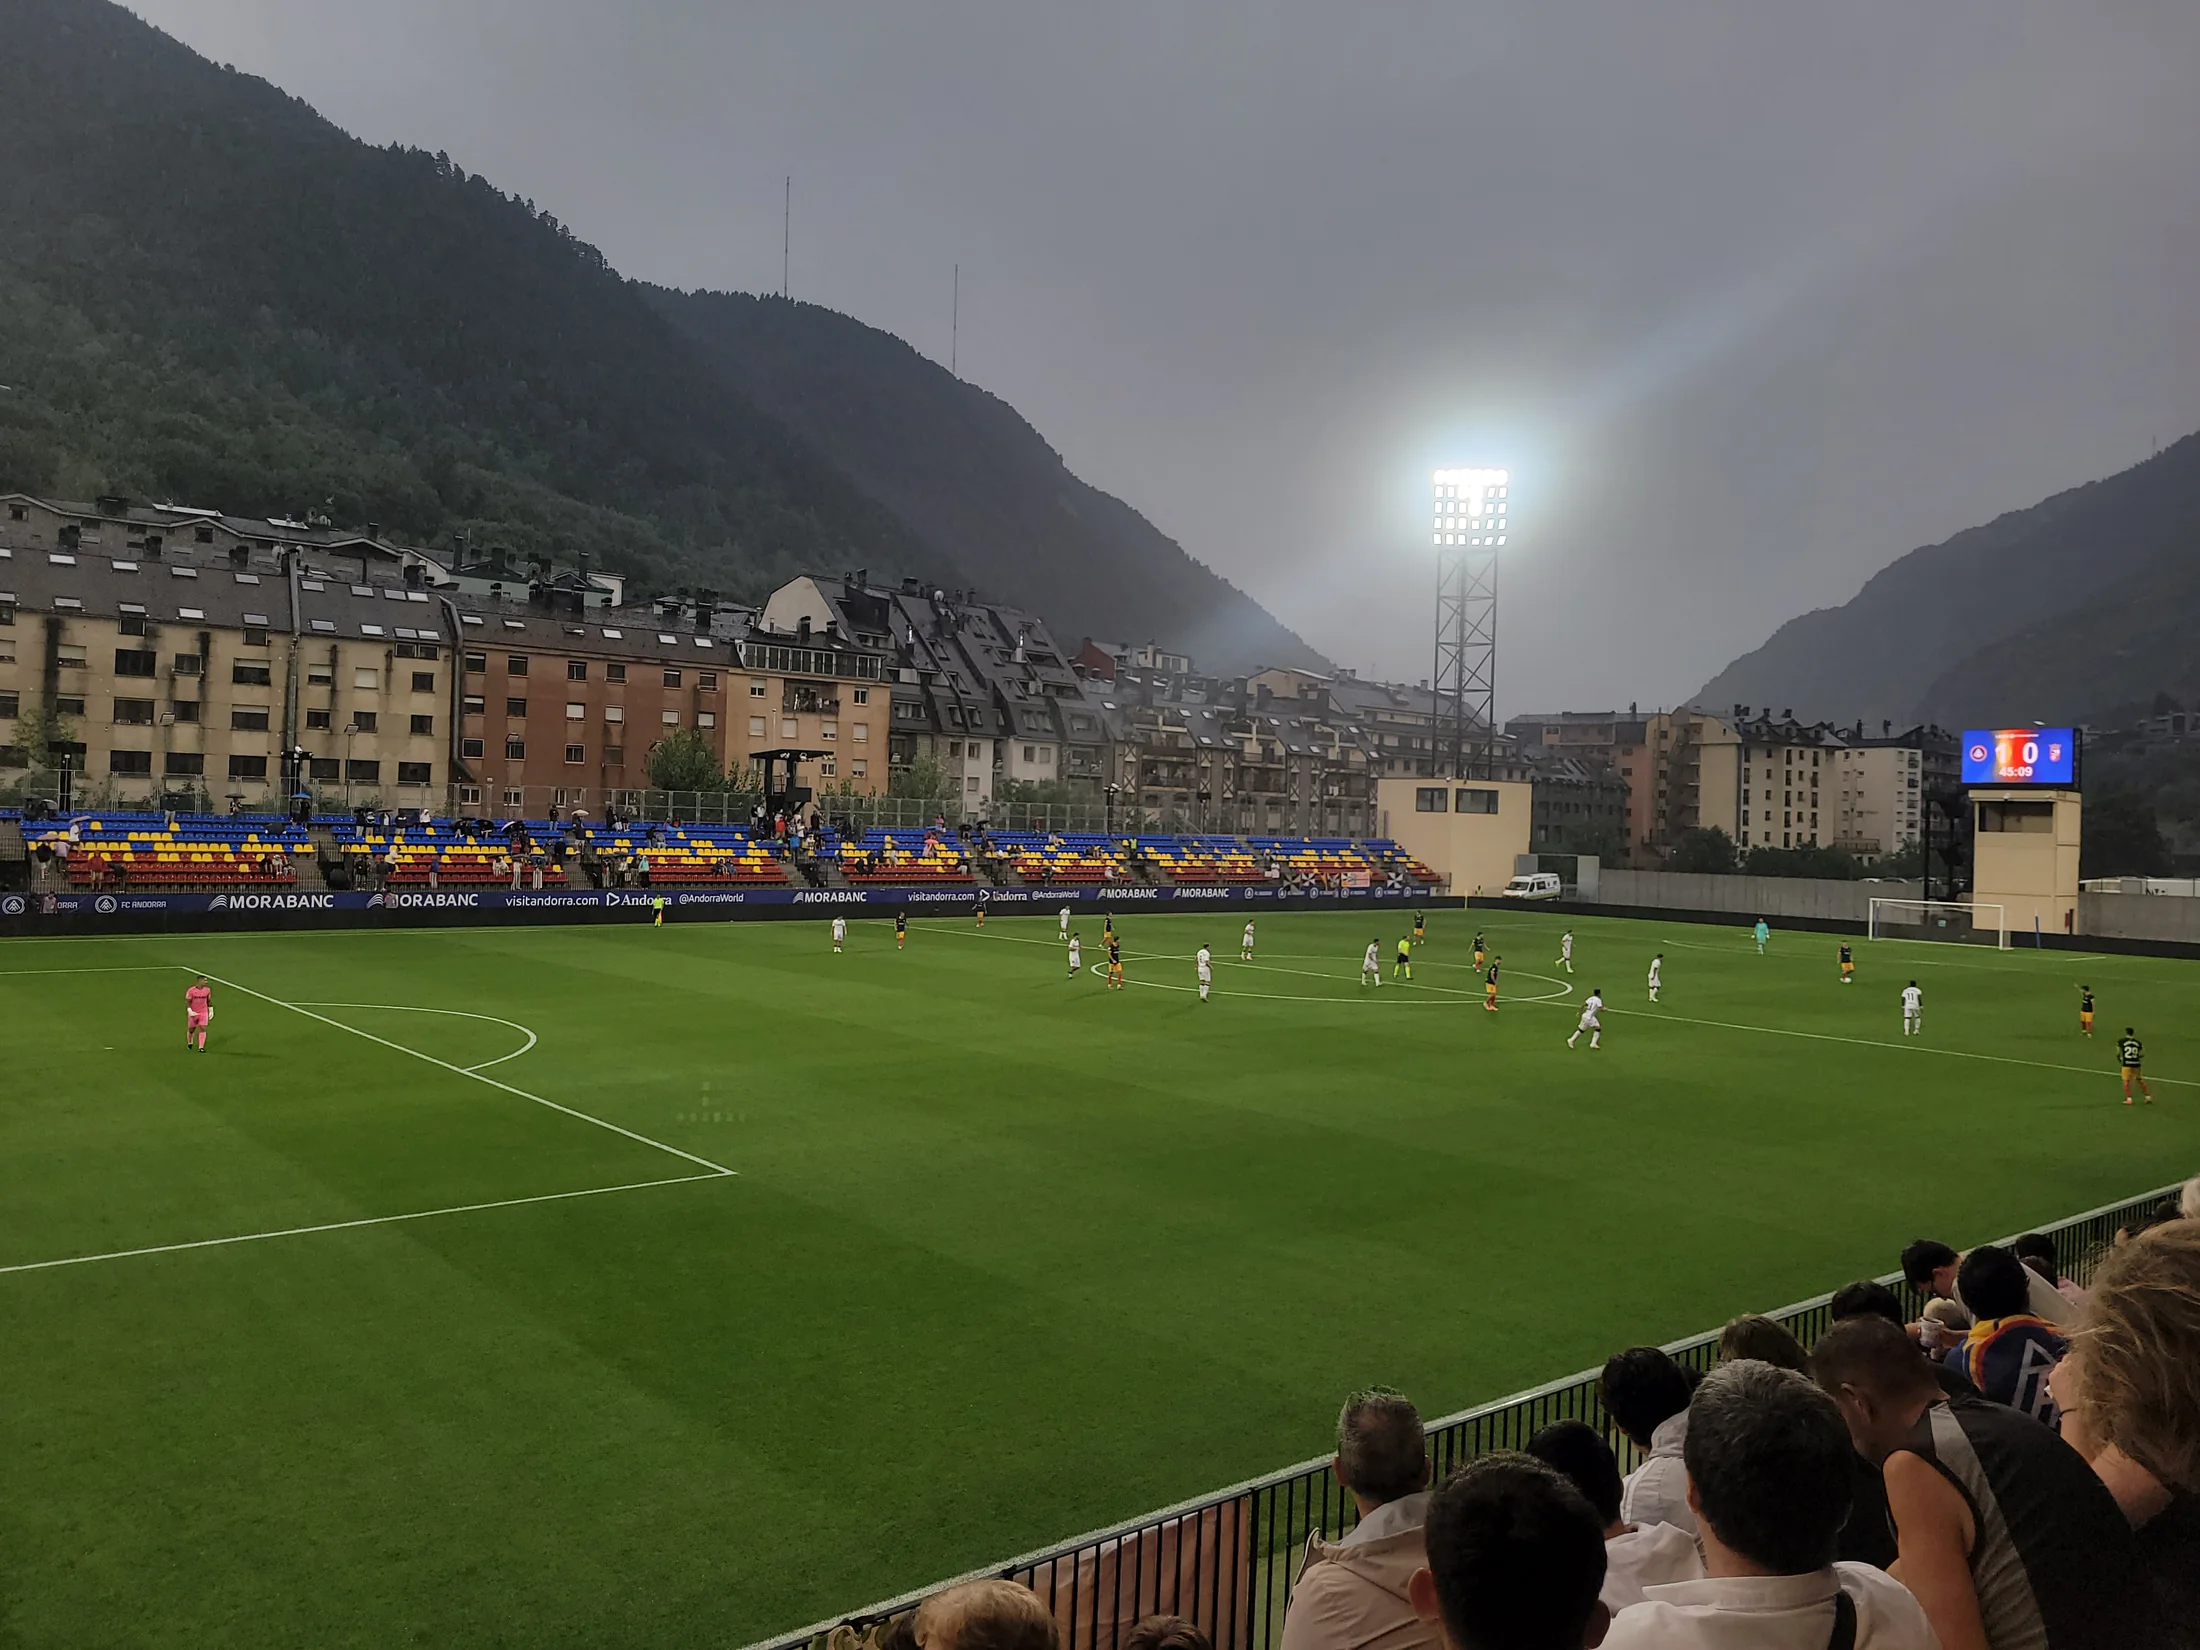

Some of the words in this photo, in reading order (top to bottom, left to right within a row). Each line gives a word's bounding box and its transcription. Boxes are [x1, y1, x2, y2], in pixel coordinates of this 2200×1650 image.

[1994, 742, 2007, 764] 1
[2022, 742, 2039, 764] 0
[1999, 766, 2033, 777] 45:09
[804, 891, 867, 903] MORABANC
[908, 891, 975, 902] visitandorra.com
[1106, 888, 1158, 899] MORABANC
[1181, 887, 1229, 898] MORABANC
[121, 901, 131, 909] FC
[132, 901, 167, 909] ANDORRA
[229, 894, 334, 909] MORABANC
[396, 893, 478, 907] ORABANC
[505, 895, 599, 907] visitandorra.com
[620, 893, 672, 906] Andoa
[679, 893, 744, 905] @AndorraWorld
[2124, 1046, 2138, 1059] 29
